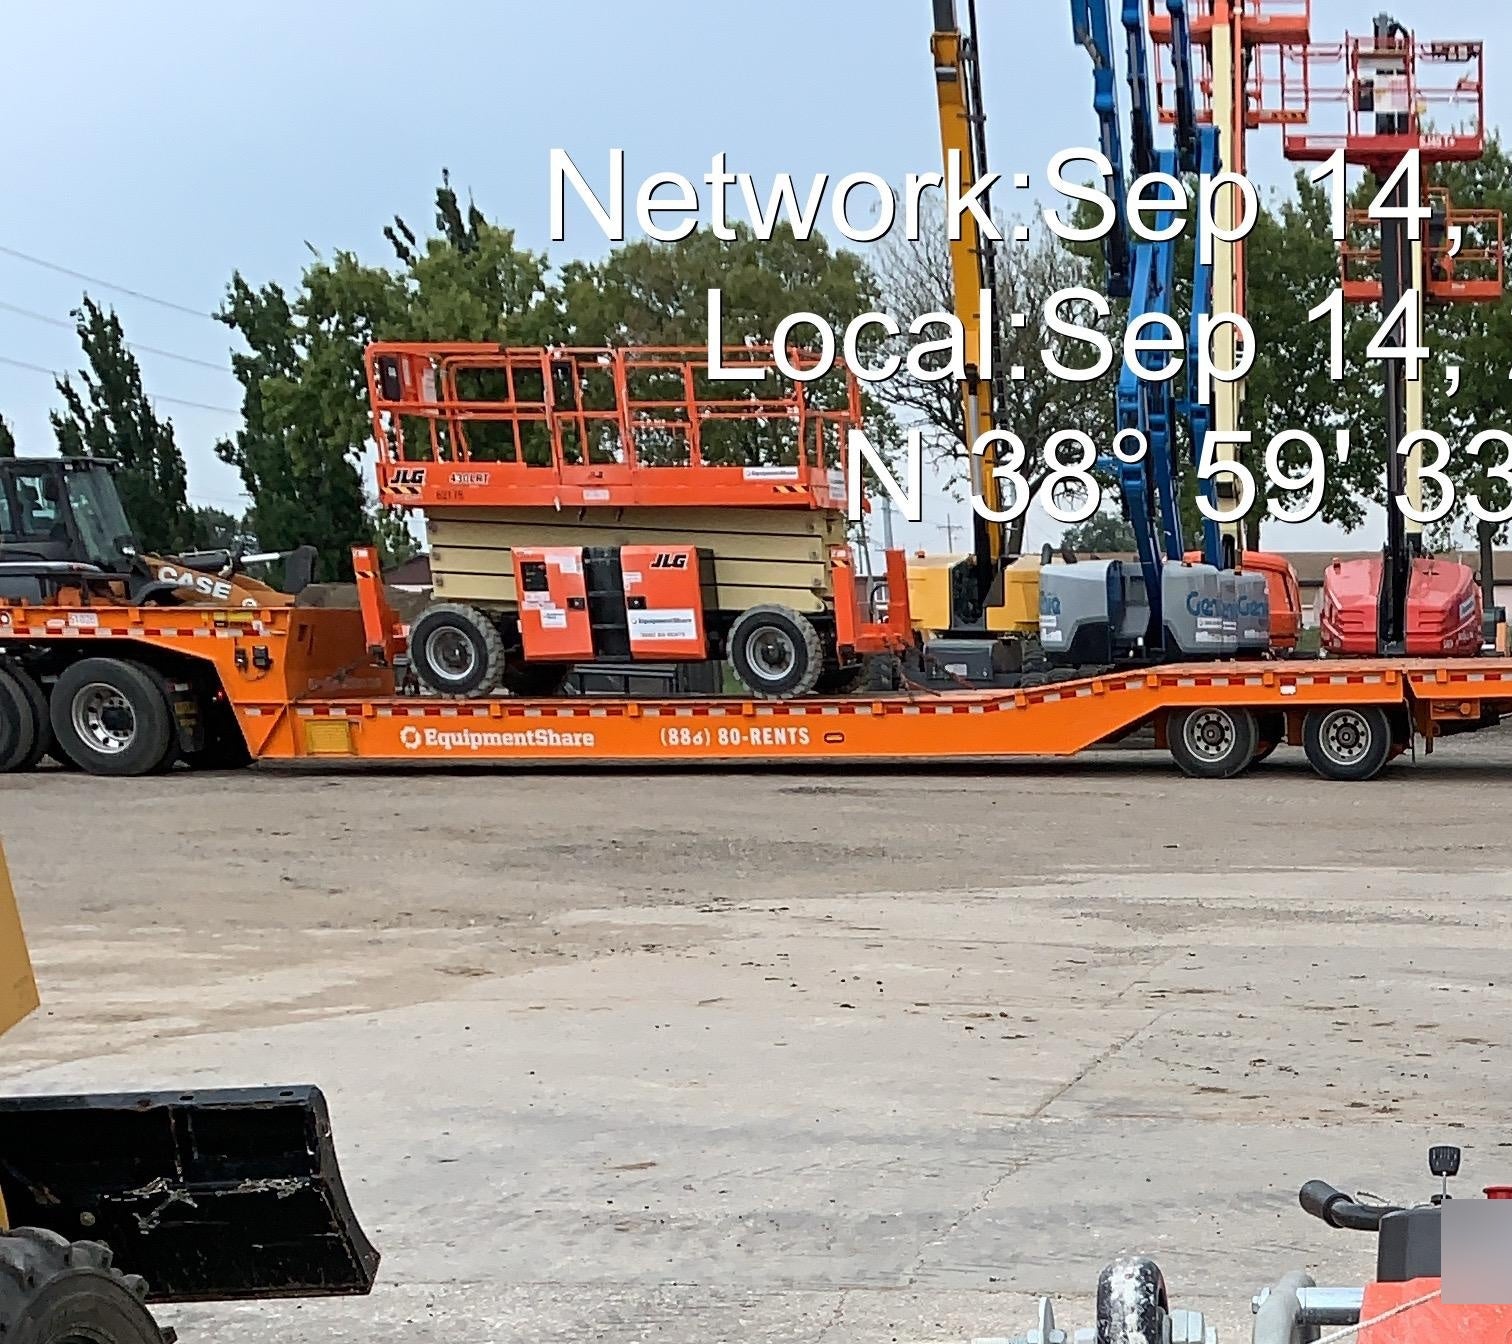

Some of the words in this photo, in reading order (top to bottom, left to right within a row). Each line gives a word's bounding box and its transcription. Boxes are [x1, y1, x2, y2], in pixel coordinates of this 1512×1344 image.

[390, 469, 425, 485] JLG
[650, 553, 688, 568] JLG
[157, 565, 233, 600] CASE
[422, 727, 596, 751] EquipmentShare
[717, 727, 811, 746] 80-RENTS
